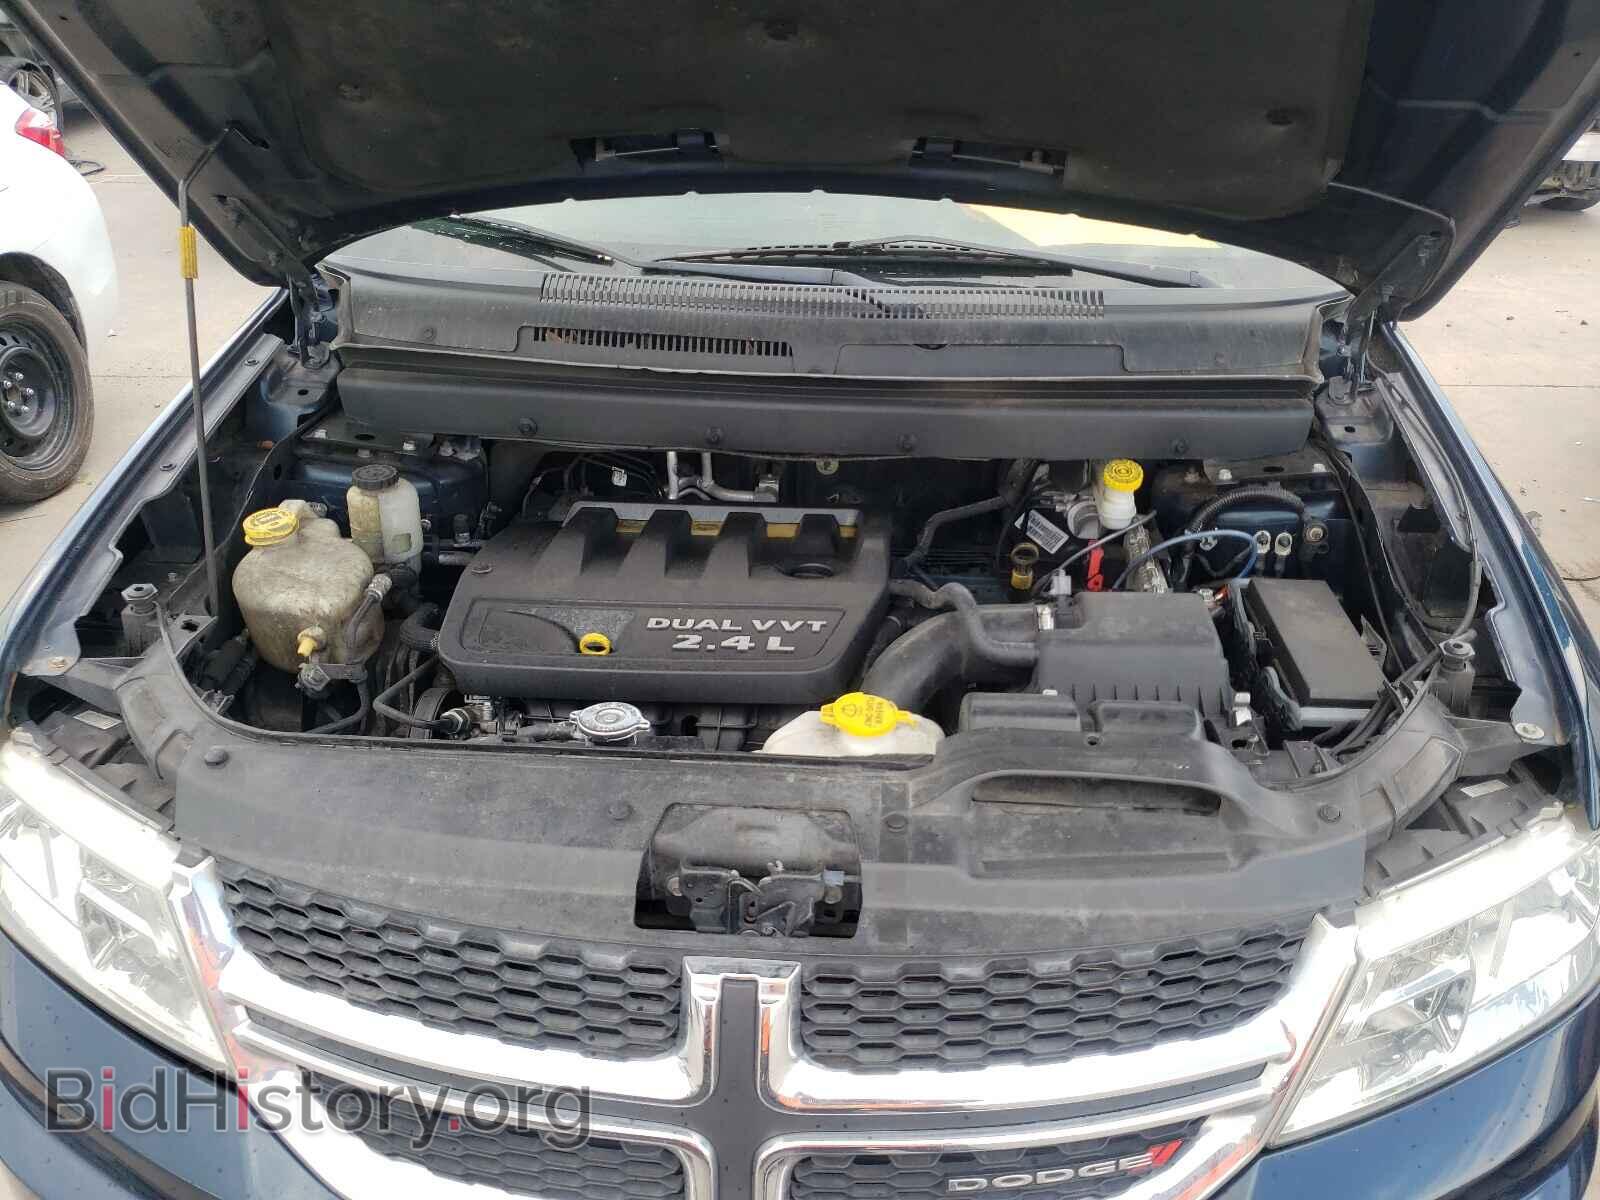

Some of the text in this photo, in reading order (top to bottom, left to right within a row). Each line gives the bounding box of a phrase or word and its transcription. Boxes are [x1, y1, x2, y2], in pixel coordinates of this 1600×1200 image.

[647, 617, 828, 632] DUAL VVT
[947, 1152, 1153, 1193] DODGE
